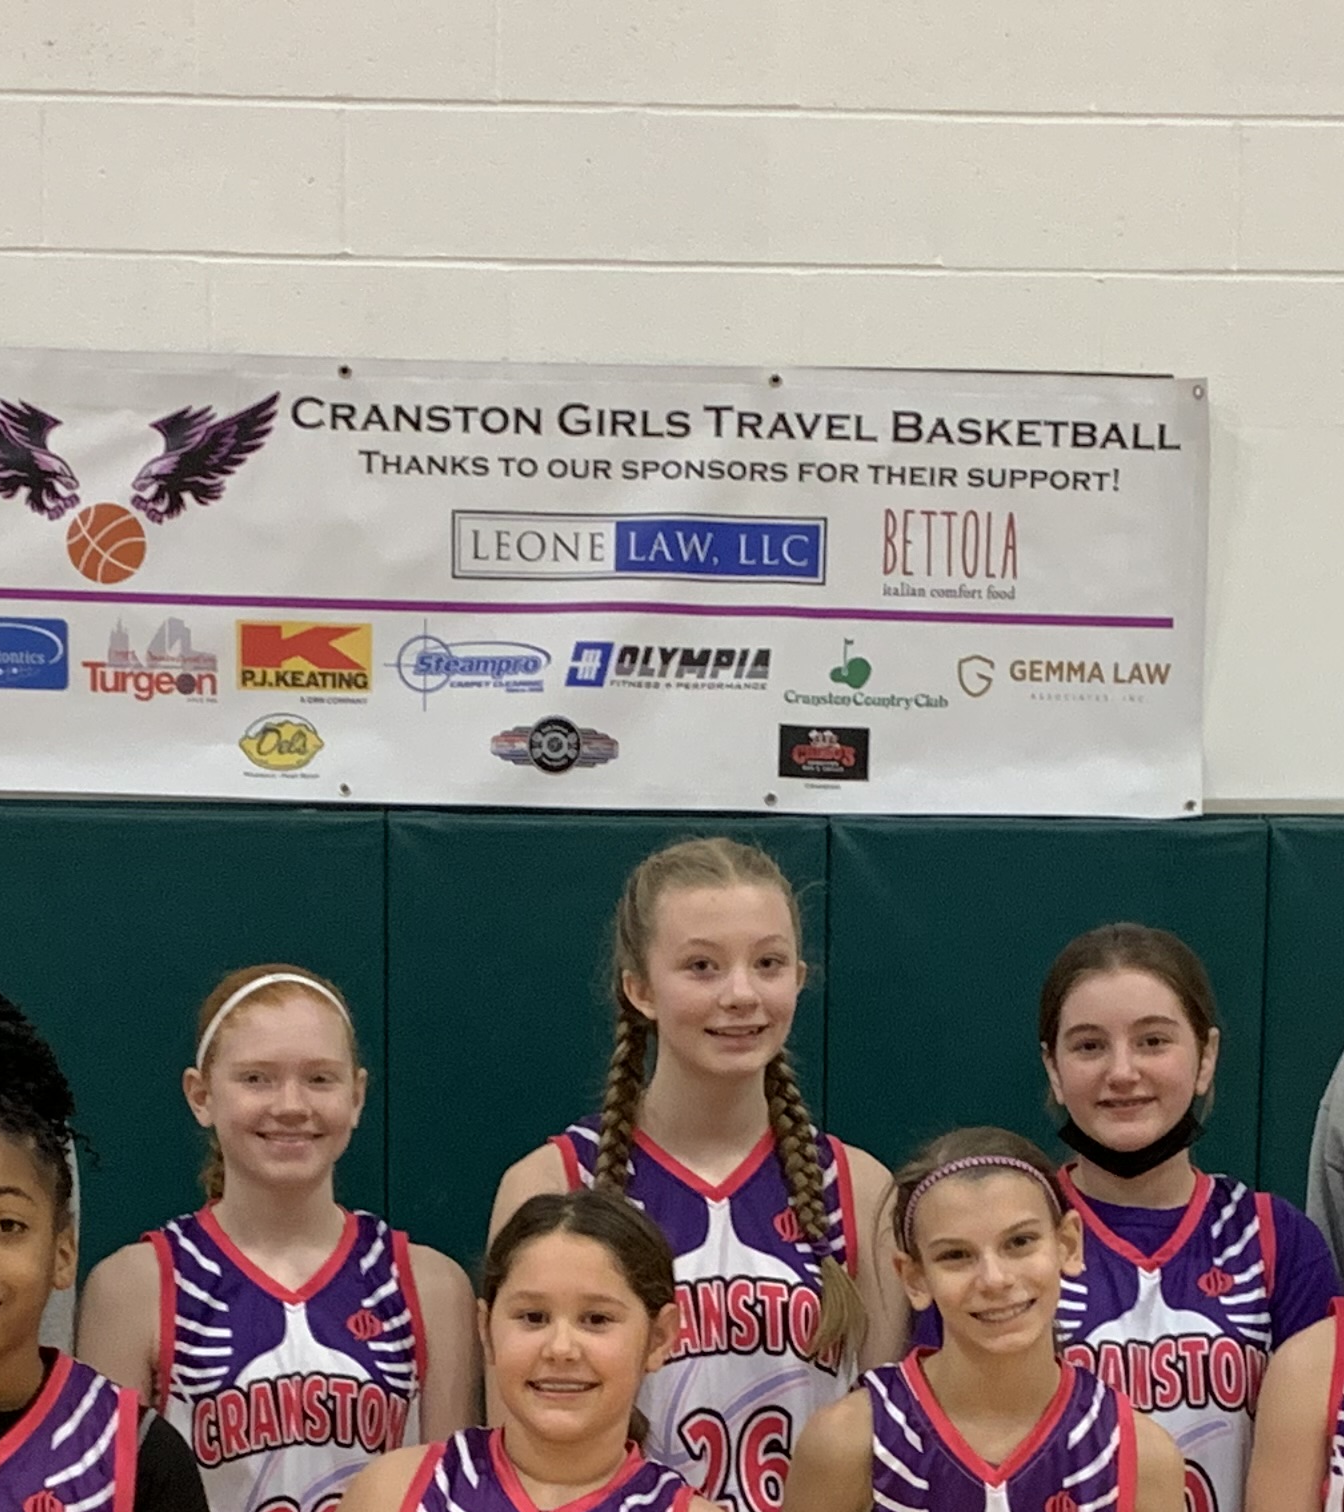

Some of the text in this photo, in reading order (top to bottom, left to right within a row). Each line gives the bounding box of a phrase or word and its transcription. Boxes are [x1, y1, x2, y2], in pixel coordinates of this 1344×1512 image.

[291, 396, 1182, 452] CRANSTON GIRLS TRAVEL BASKETBALL
[358, 450, 1121, 493] THANKS TO OUR SPONSORS FOR THEIR SUPPORT!
[471, 529, 811, 567] LEONE LAW, LLC
[882, 508, 1018, 580] BETTOLA
[882, 583, 1016, 600] italian comfort food
[82, 661, 218, 702] Turgeon
[413, 652, 542, 677] Steampro
[614, 645, 772, 680] OLYMPIA
[1009, 660, 1172, 686] GEMMA LAW
[664, 1276, 841, 1377] ANSTO
